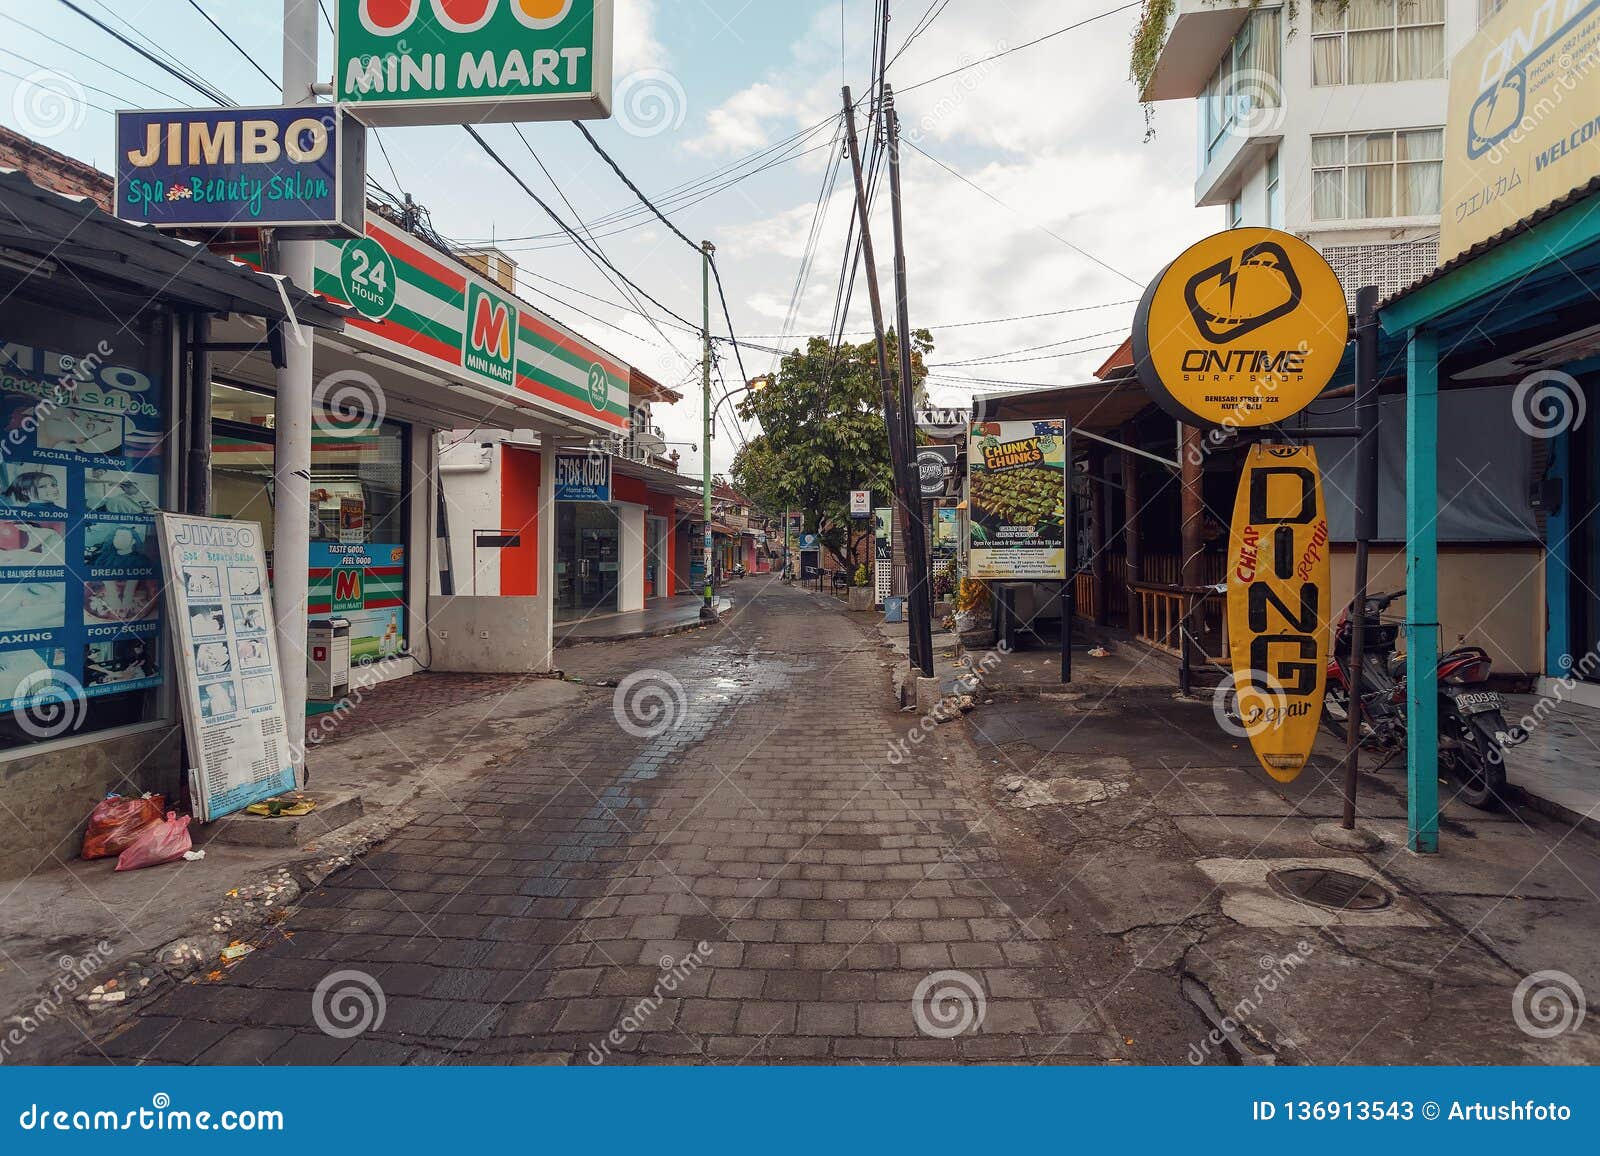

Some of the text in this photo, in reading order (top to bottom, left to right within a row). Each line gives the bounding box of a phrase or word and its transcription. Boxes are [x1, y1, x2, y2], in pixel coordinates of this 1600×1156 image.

[345, 47, 586, 94] MINI MART
[128, 118, 328, 167] JIMBO
[128, 171, 328, 216] Spa Beauty Salon
[351, 249, 387, 293] 24
[352, 281, 384, 306] Hours
[467, 354, 512, 382] MINI MART
[1181, 349, 1308, 373] ONTIME
[592, 371, 605, 395] 24
[33, 450, 72, 461] FACIAL
[985, 438, 1038, 458] CHUNKY
[987, 449, 1041, 469] CHUNKS
[175, 524, 254, 547] JIMBO
[328, 545, 348, 553] TASTE
[356, 557, 371, 565] GOOD
[1237, 526, 1259, 583] CHEAP
[91, 568, 152, 577] DREAD LOCK
[1248, 467, 1319, 696] DING
[0, 632, 53, 644] AXING
[88, 623, 156, 637] FOOT SCRUB
[1248, 700, 1311, 726] Repair
